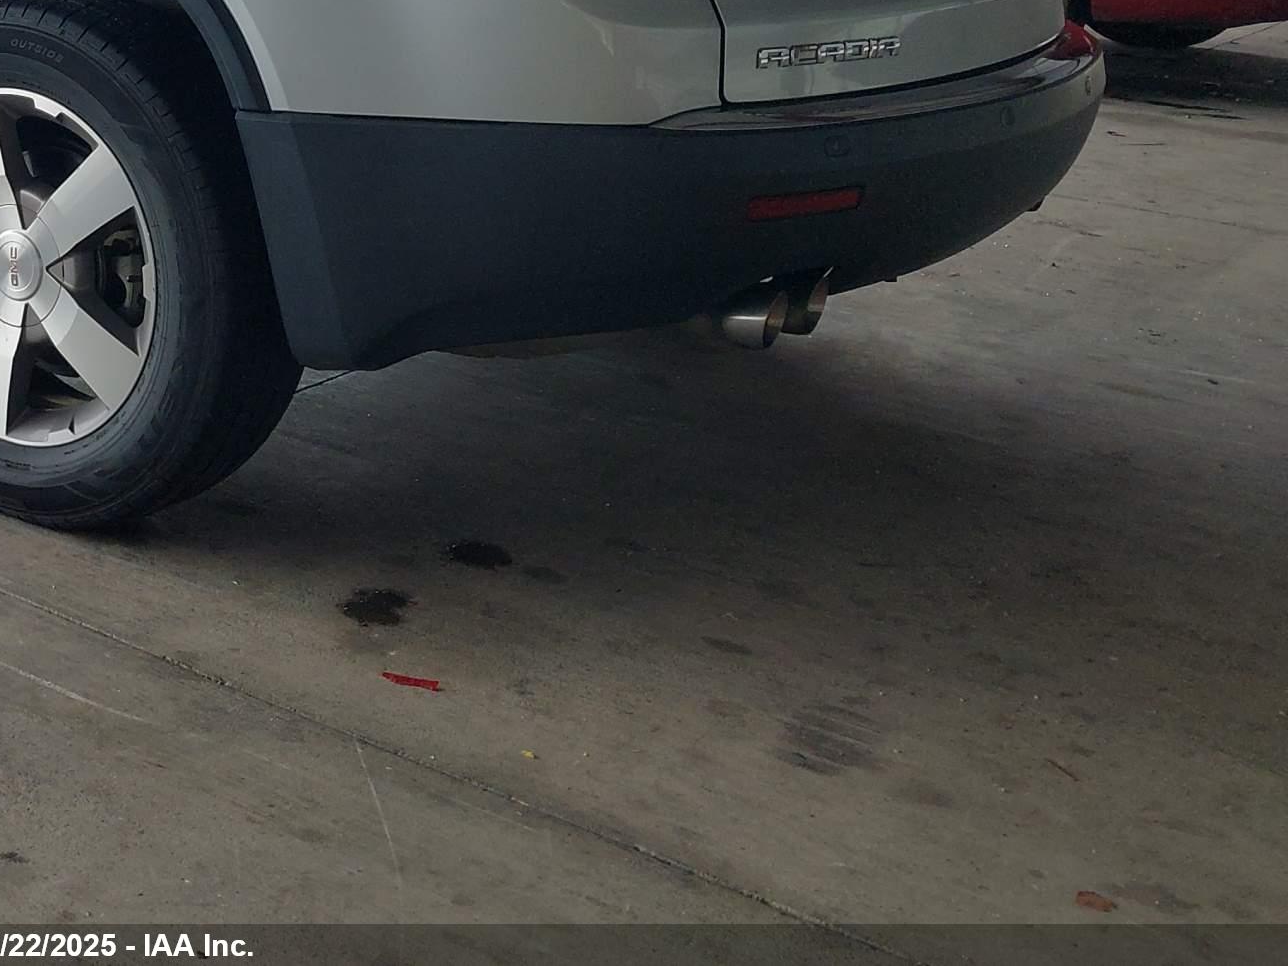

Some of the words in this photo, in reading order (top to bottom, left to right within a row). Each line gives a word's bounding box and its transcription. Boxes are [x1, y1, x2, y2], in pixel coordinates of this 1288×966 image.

[10, 38, 64, 63] OUTSIDE
[756, 36, 901, 69] ACADIA
[10, 246, 19, 287] GMC
